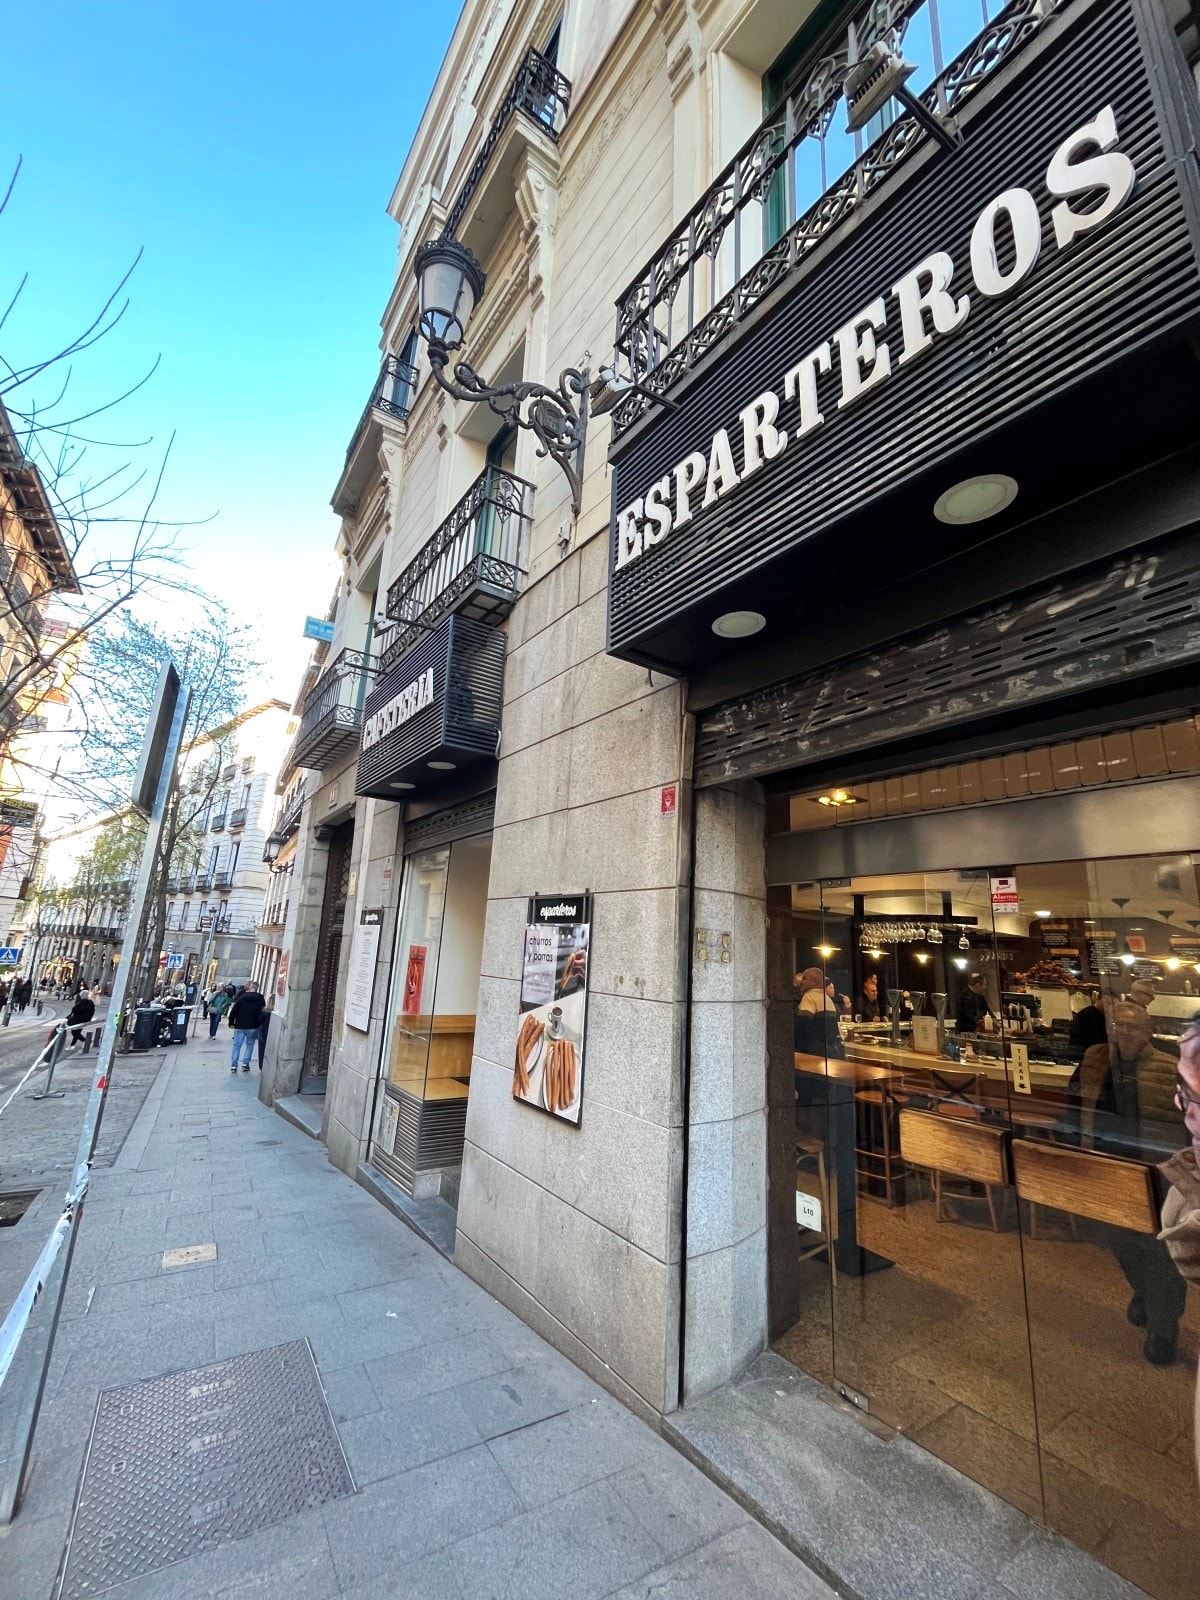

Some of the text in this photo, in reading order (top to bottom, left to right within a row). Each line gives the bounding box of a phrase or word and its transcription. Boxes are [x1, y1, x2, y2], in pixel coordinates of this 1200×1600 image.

[614, 104, 1137, 571] ESPARTEROS
[6, 799, 37, 809] HOSTAL
[540, 903, 577, 920] esparteros
[529, 937, 552, 947] churros
[527, 952, 553, 963] y porras
[803, 1206, 814, 1217] L10
